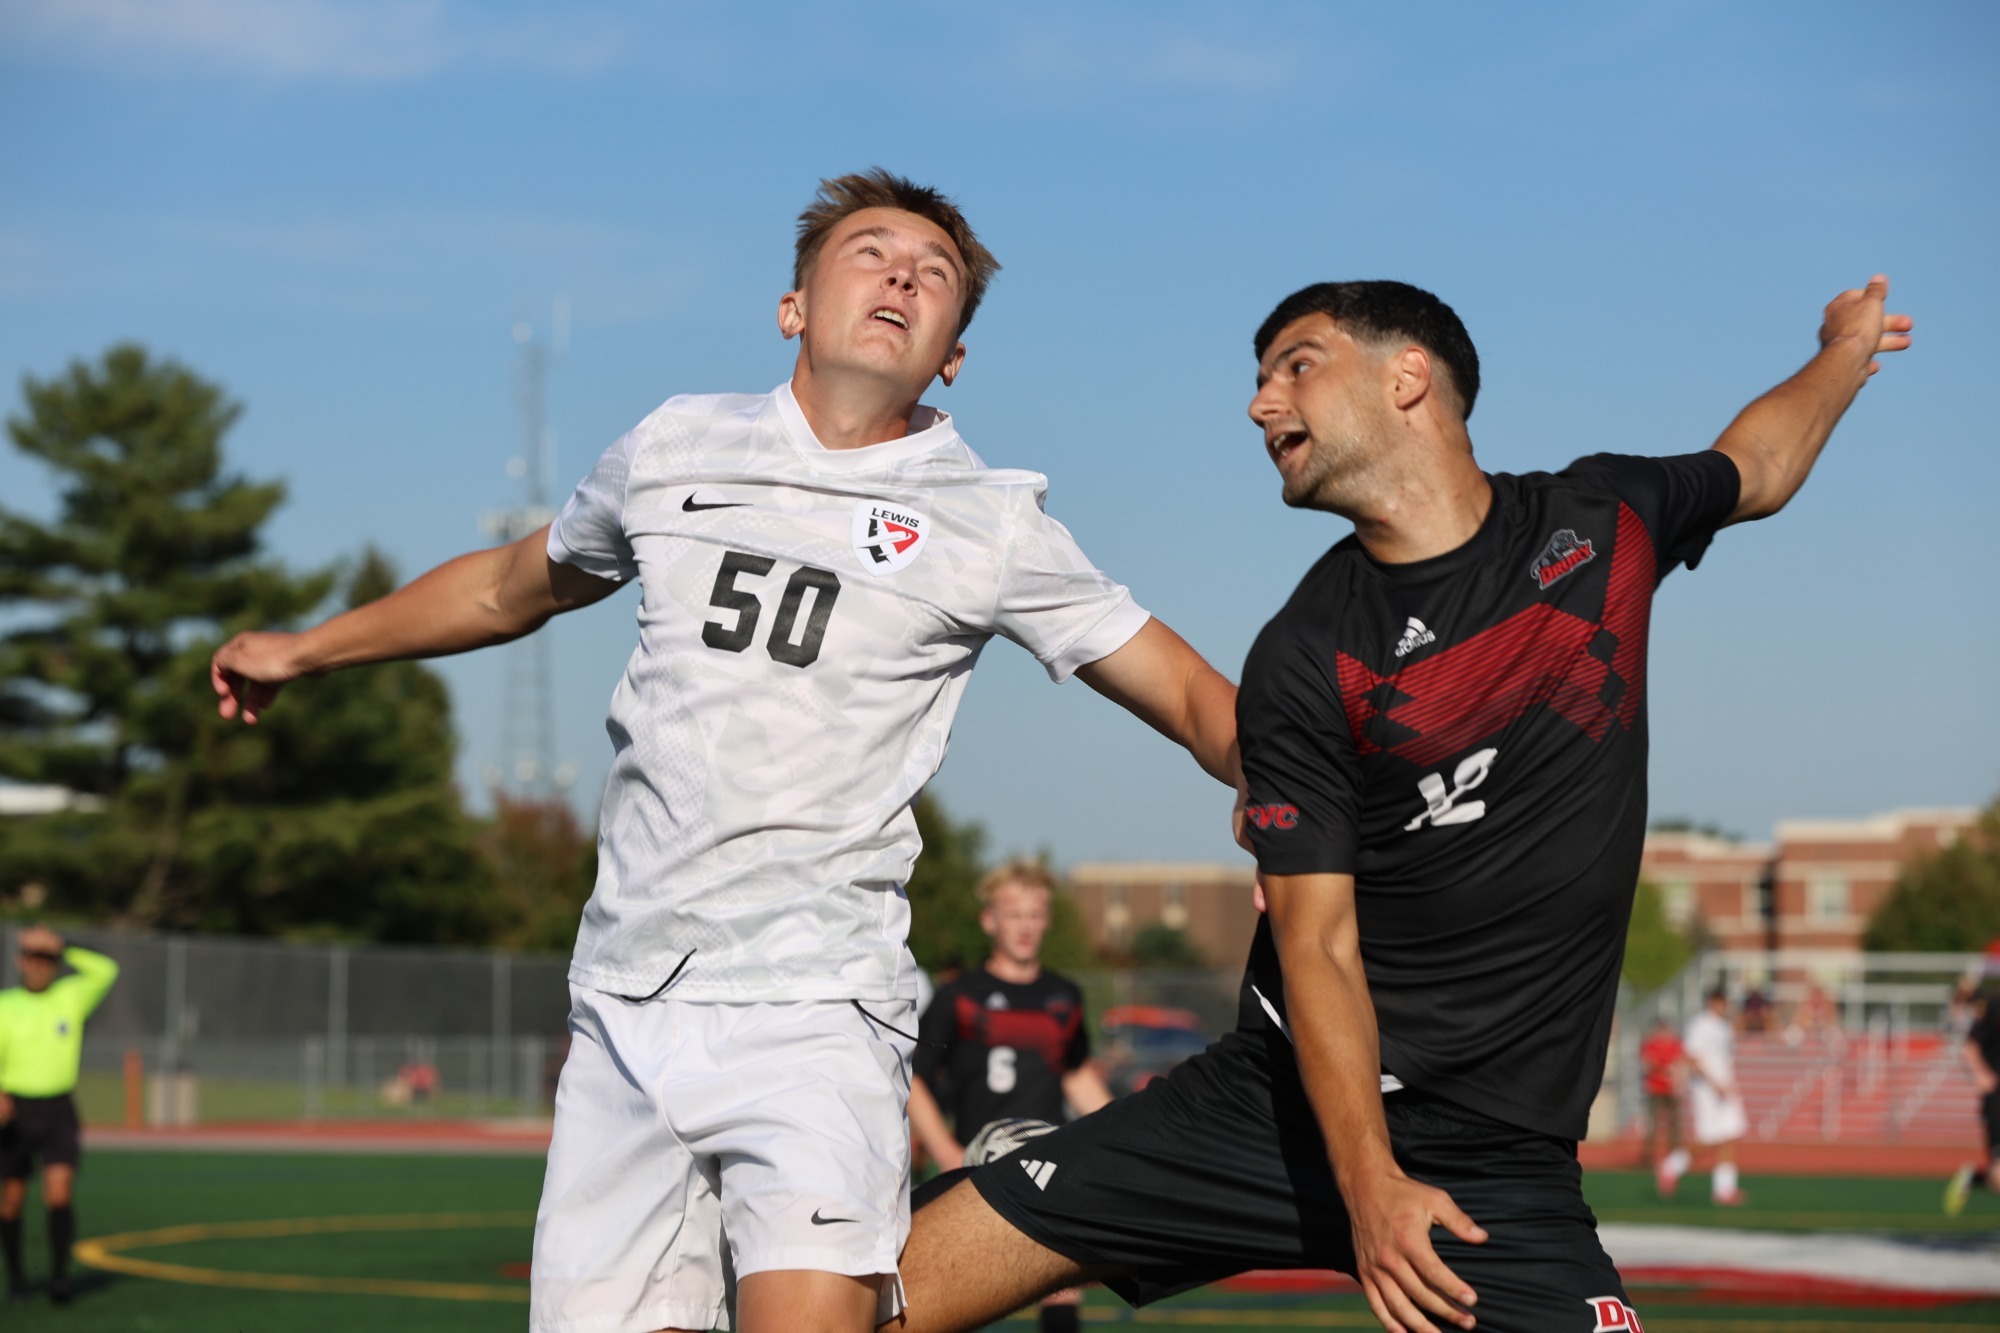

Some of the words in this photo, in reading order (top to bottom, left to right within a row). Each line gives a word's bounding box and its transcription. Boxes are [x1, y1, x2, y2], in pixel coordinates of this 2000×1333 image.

[871, 507, 920, 528] LEWIS
[1540, 543, 1592, 585] DRURY
[701, 550, 842, 668] 50
[986, 1045, 1018, 1094] 6
